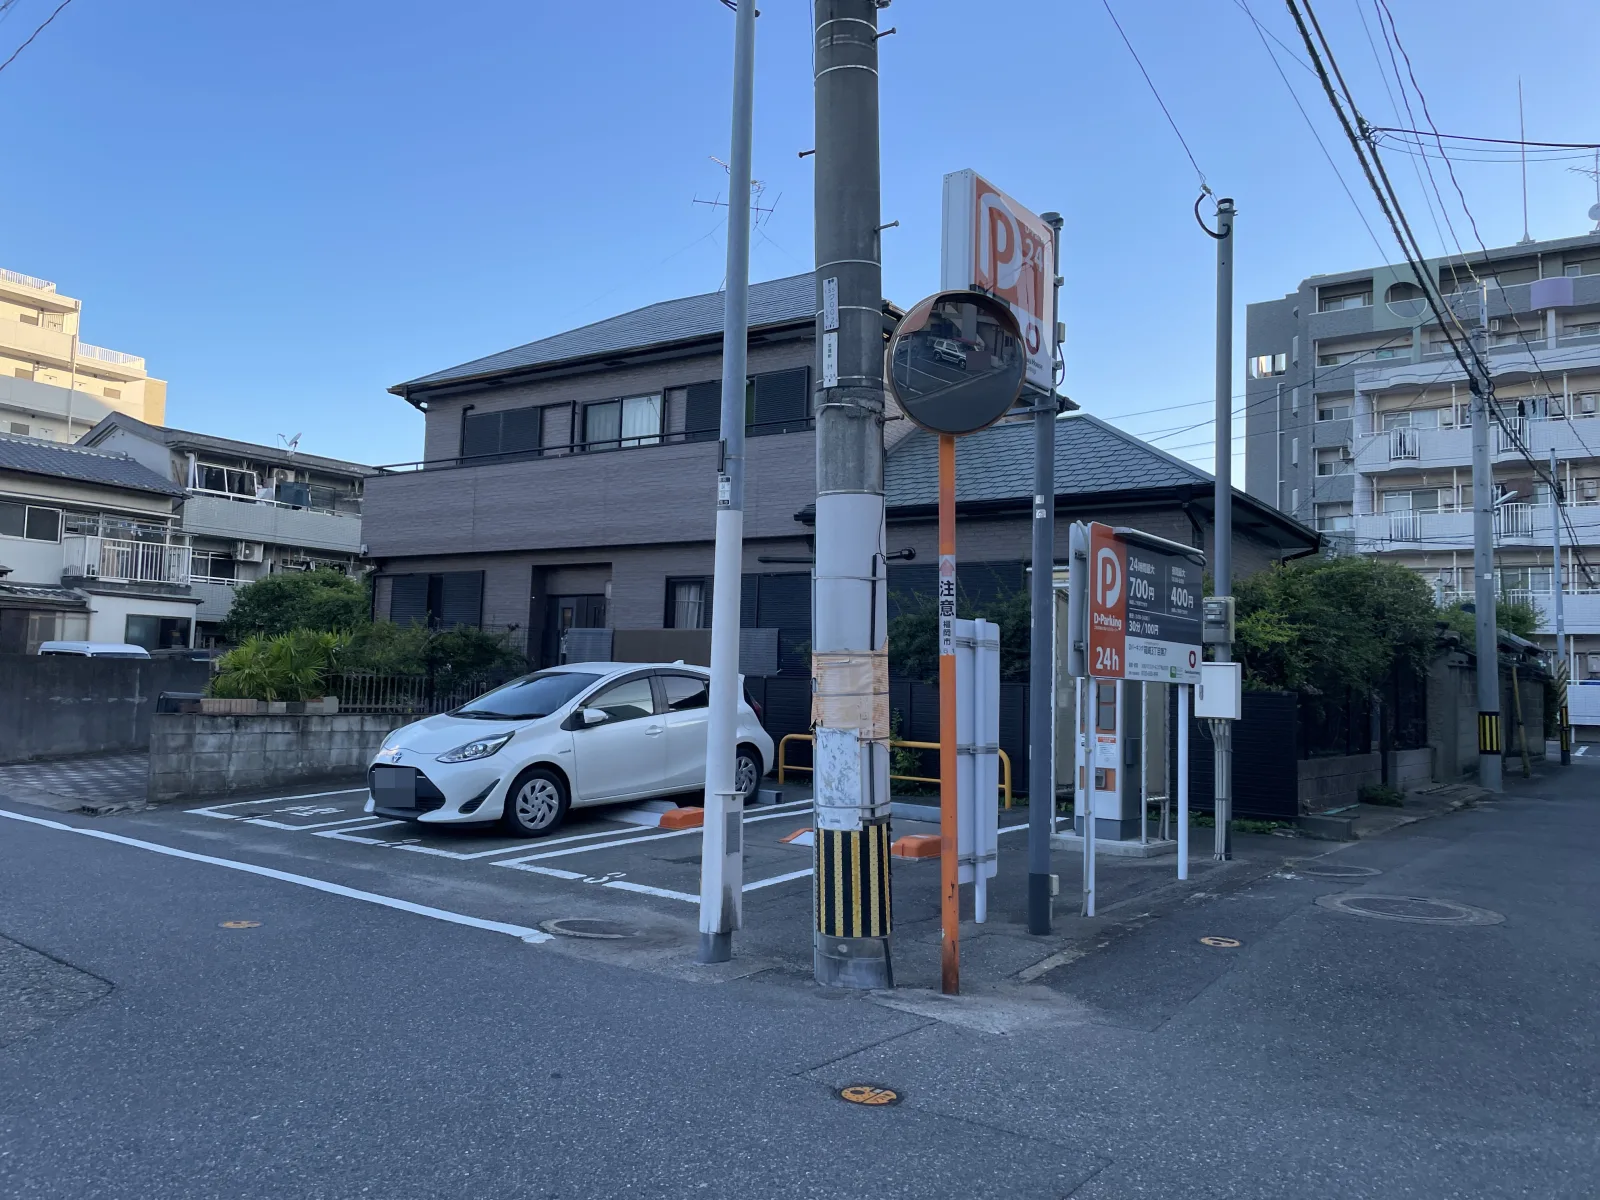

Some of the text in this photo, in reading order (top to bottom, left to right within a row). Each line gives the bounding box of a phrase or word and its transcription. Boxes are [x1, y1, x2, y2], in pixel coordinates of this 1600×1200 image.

[940, 580, 954, 617] 注意
[1129, 576, 1155, 601] 700円
[1171, 587, 1194, 608] 400円
[942, 620, 951, 646] 福岡市
[1094, 612, 1122, 630] D-Parking
[1096, 646, 1119, 671] 24h
